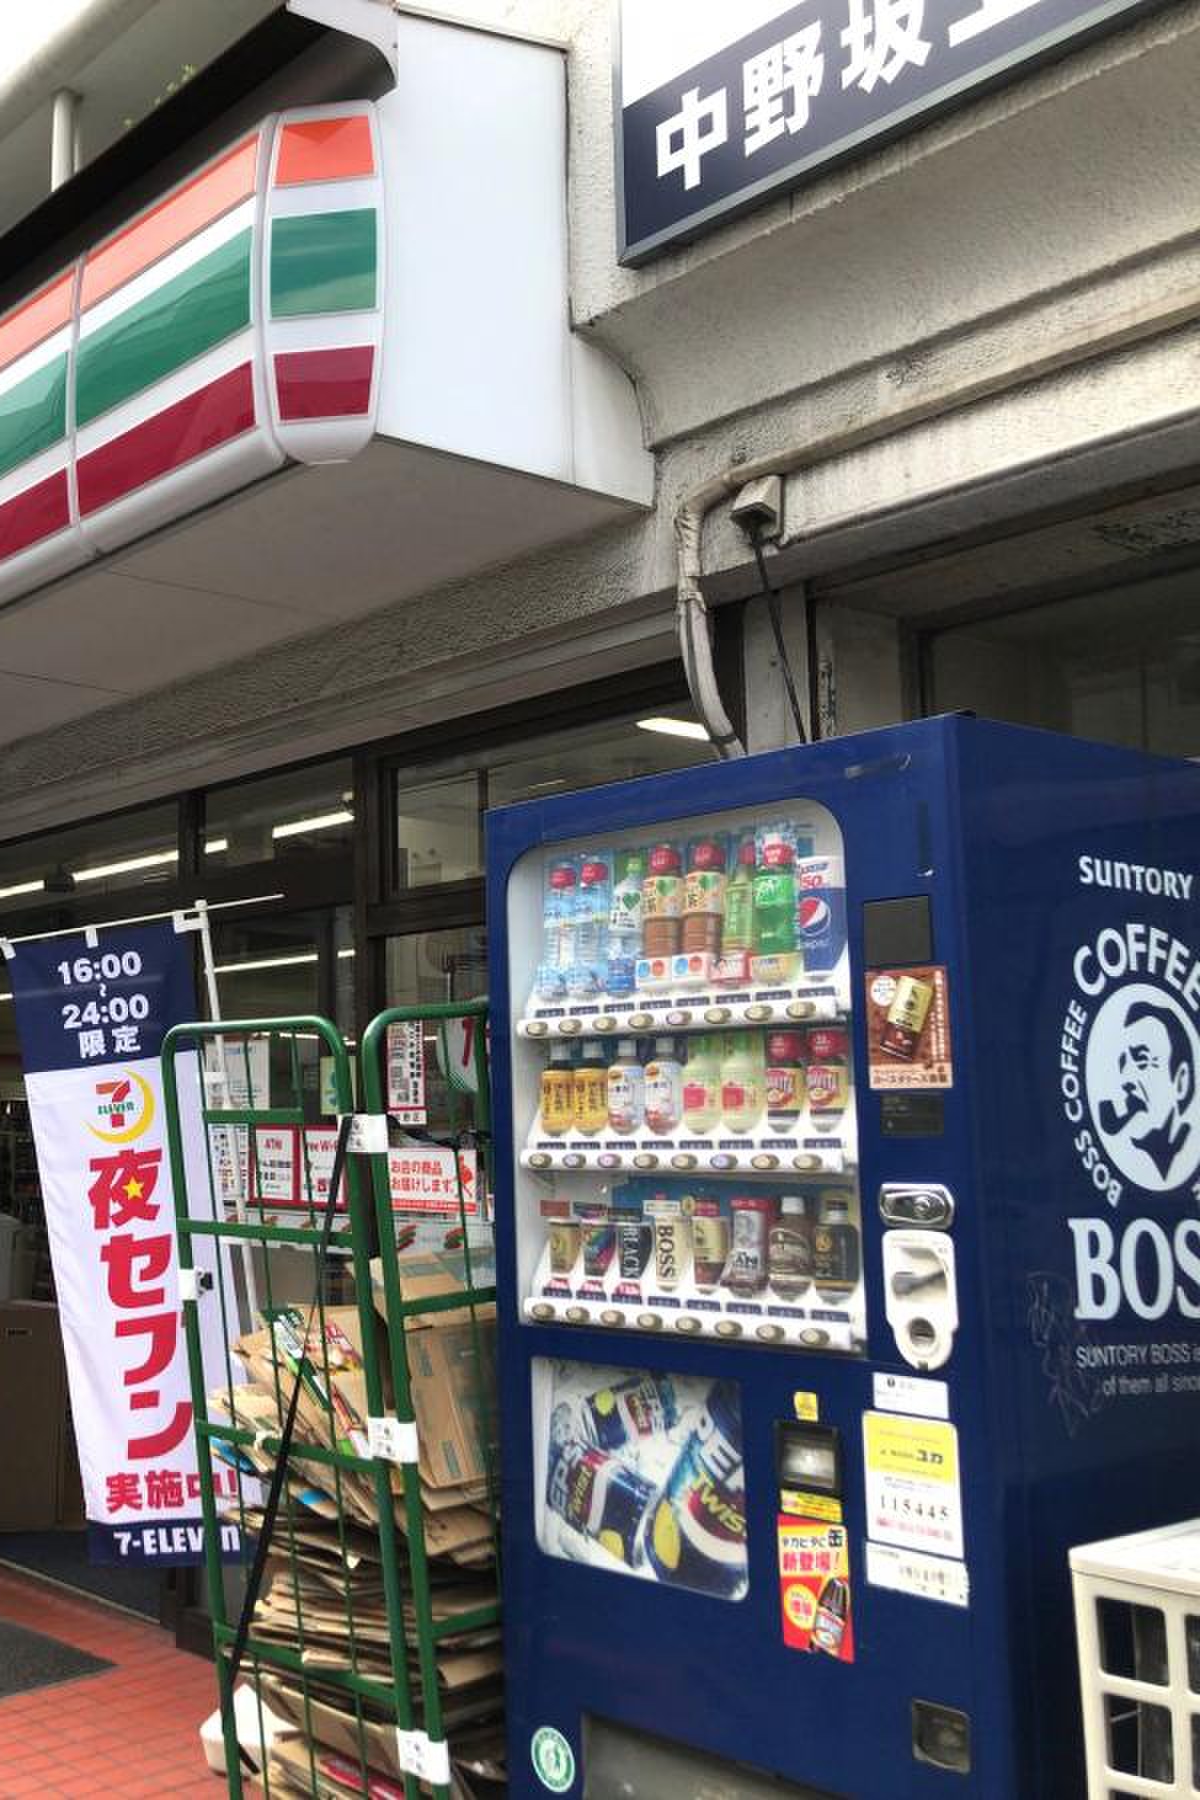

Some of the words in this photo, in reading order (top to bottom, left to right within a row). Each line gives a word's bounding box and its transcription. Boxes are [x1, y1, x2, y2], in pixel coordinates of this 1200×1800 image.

[58, 951, 142, 985] 16:00
[62, 994, 149, 1030] 24:00
[79, 1025, 141, 1059] 限定
[1061, 1000, 1088, 1122] COFFEE
[1074, 1129, 1123, 1208] BOSS
[658, 1224, 674, 1277] BOSS
[1075, 1344, 1150, 1369] SUNTORY
[113, 1525, 241, 1555] 7-ELEVn
